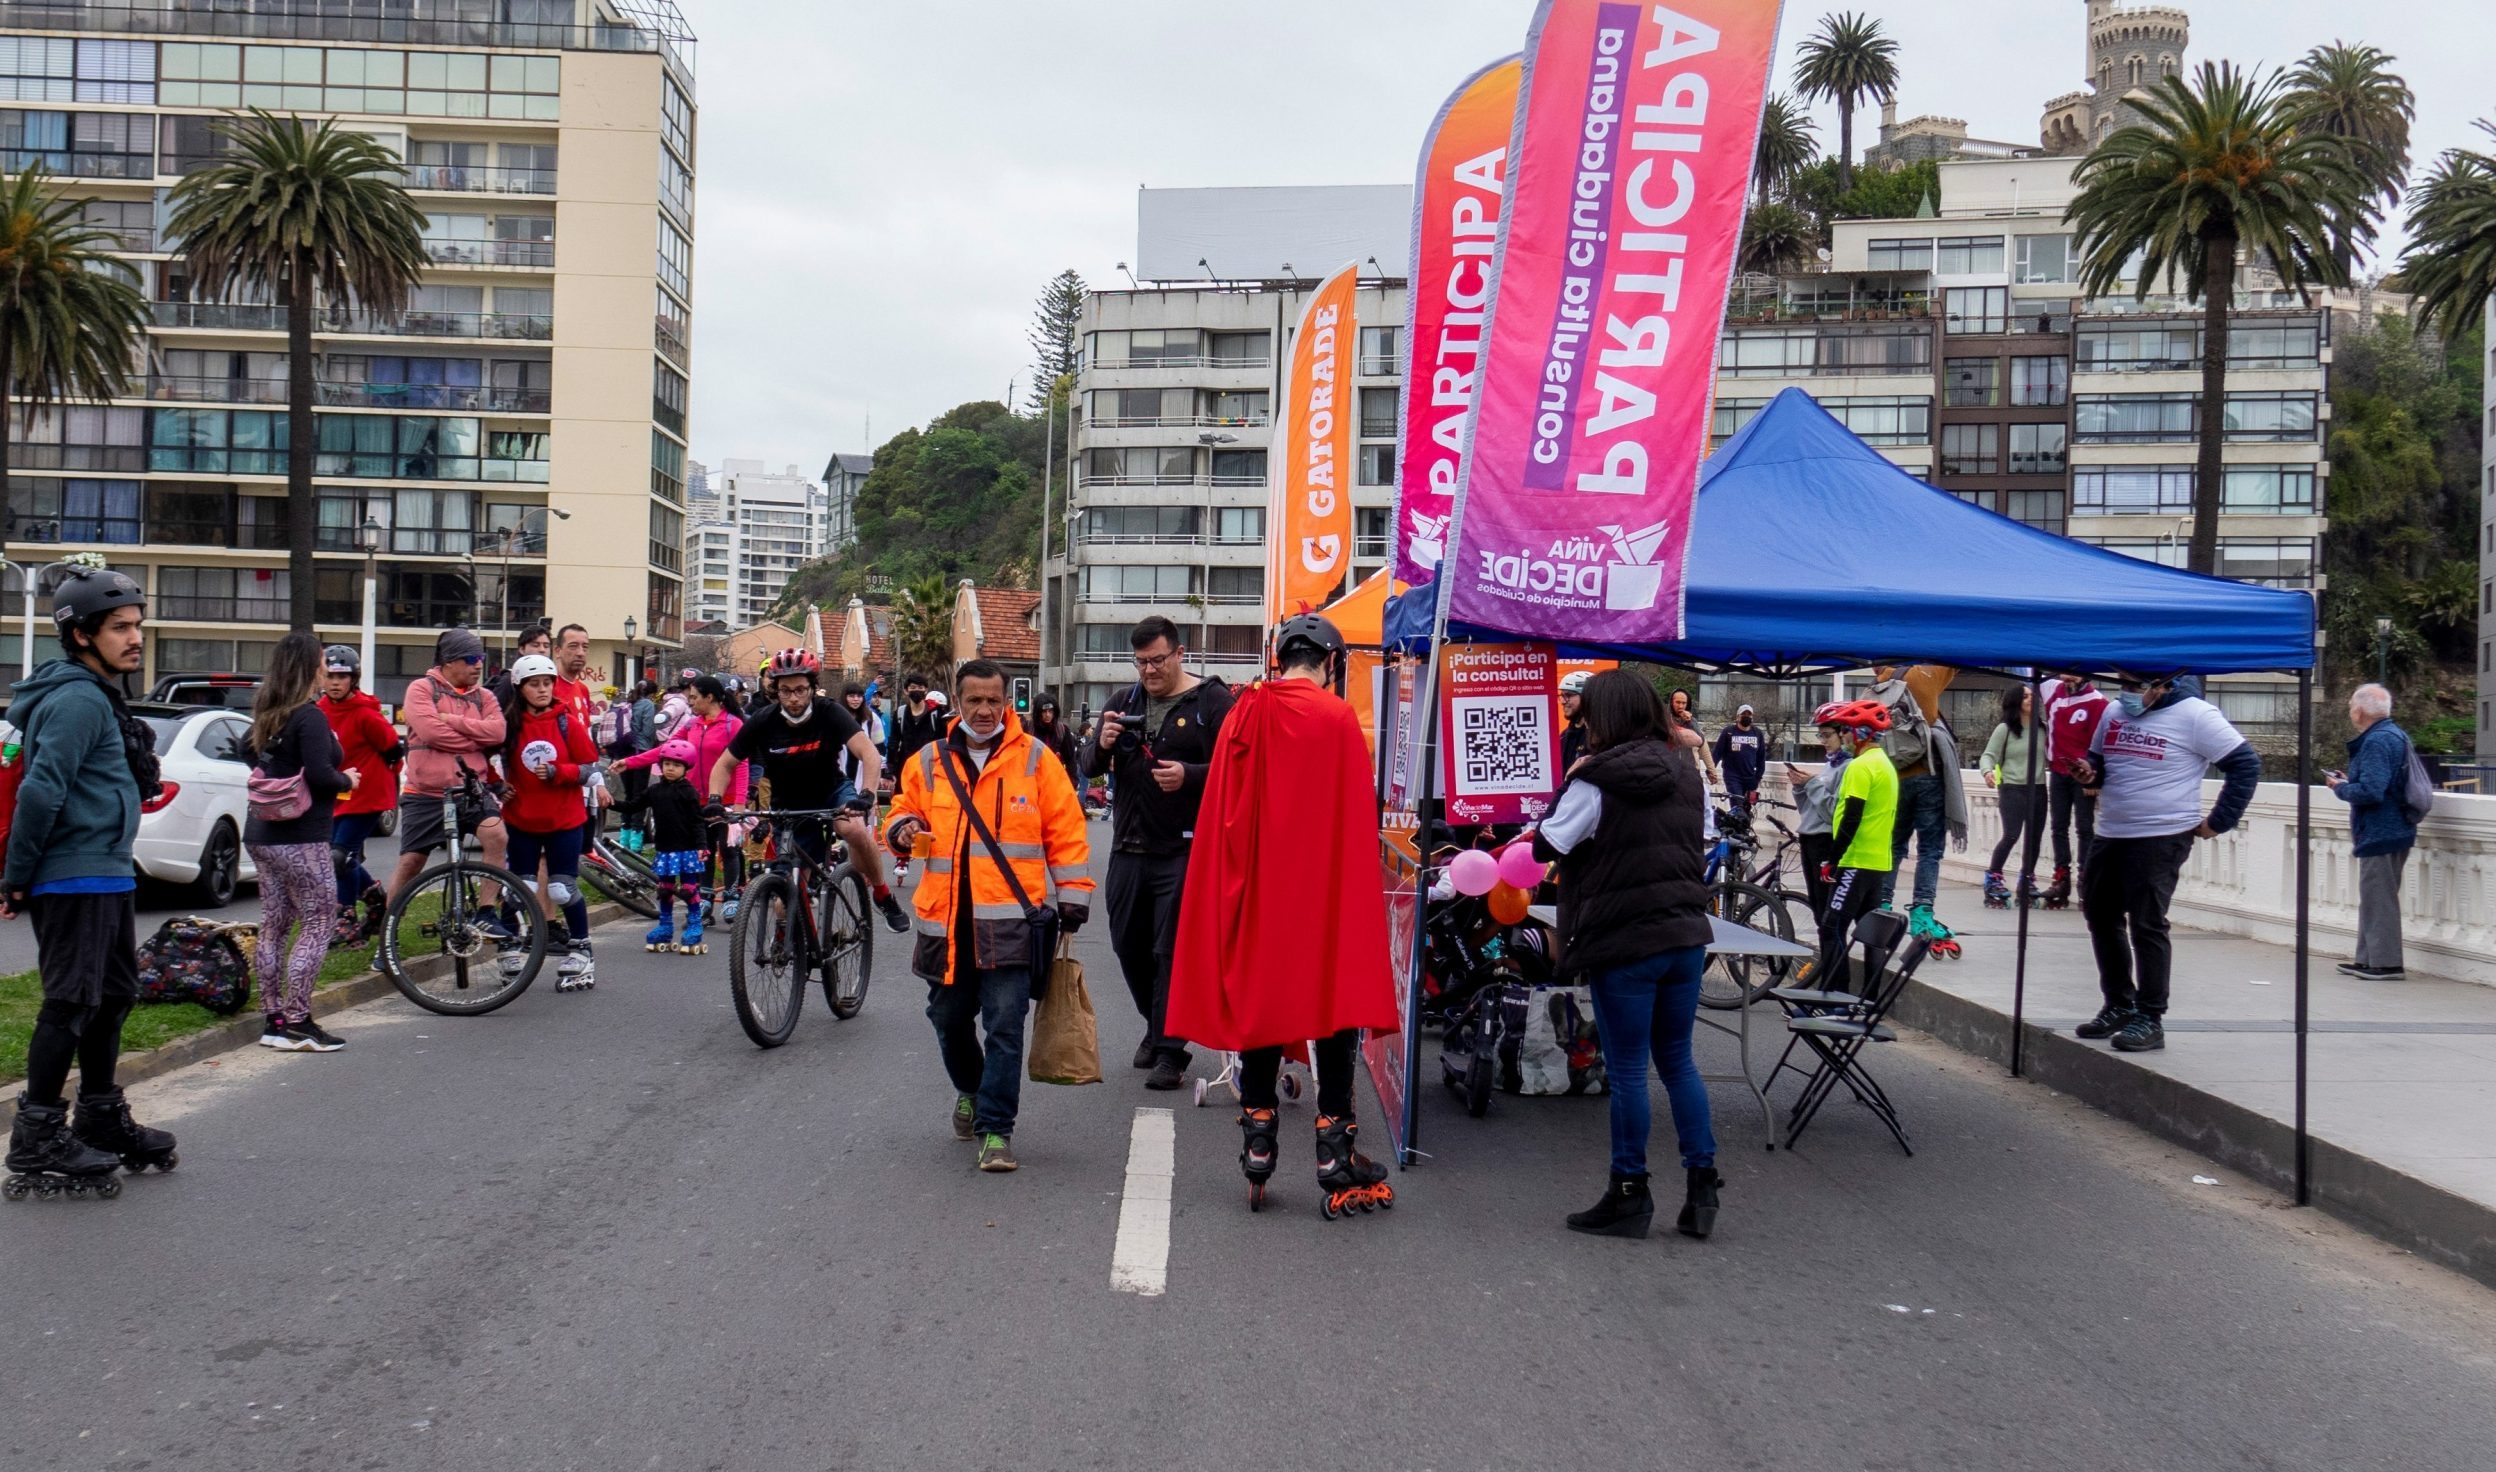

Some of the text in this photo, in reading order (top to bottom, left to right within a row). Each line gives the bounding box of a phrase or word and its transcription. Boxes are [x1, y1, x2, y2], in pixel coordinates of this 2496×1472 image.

[1429, 147, 1507, 494] PARTICIPA
[1302, 303, 1341, 574] G GATORADE
[865, 575, 893, 585] HOTEL
[1449, 651, 1525, 668] ¡Participa
[1528, 653, 1547, 664] en
[1452, 667, 1544, 682] la consulta!
[1731, 736, 1758, 745] MANCHESTER
[1830, 869, 1858, 910] STRAVA
